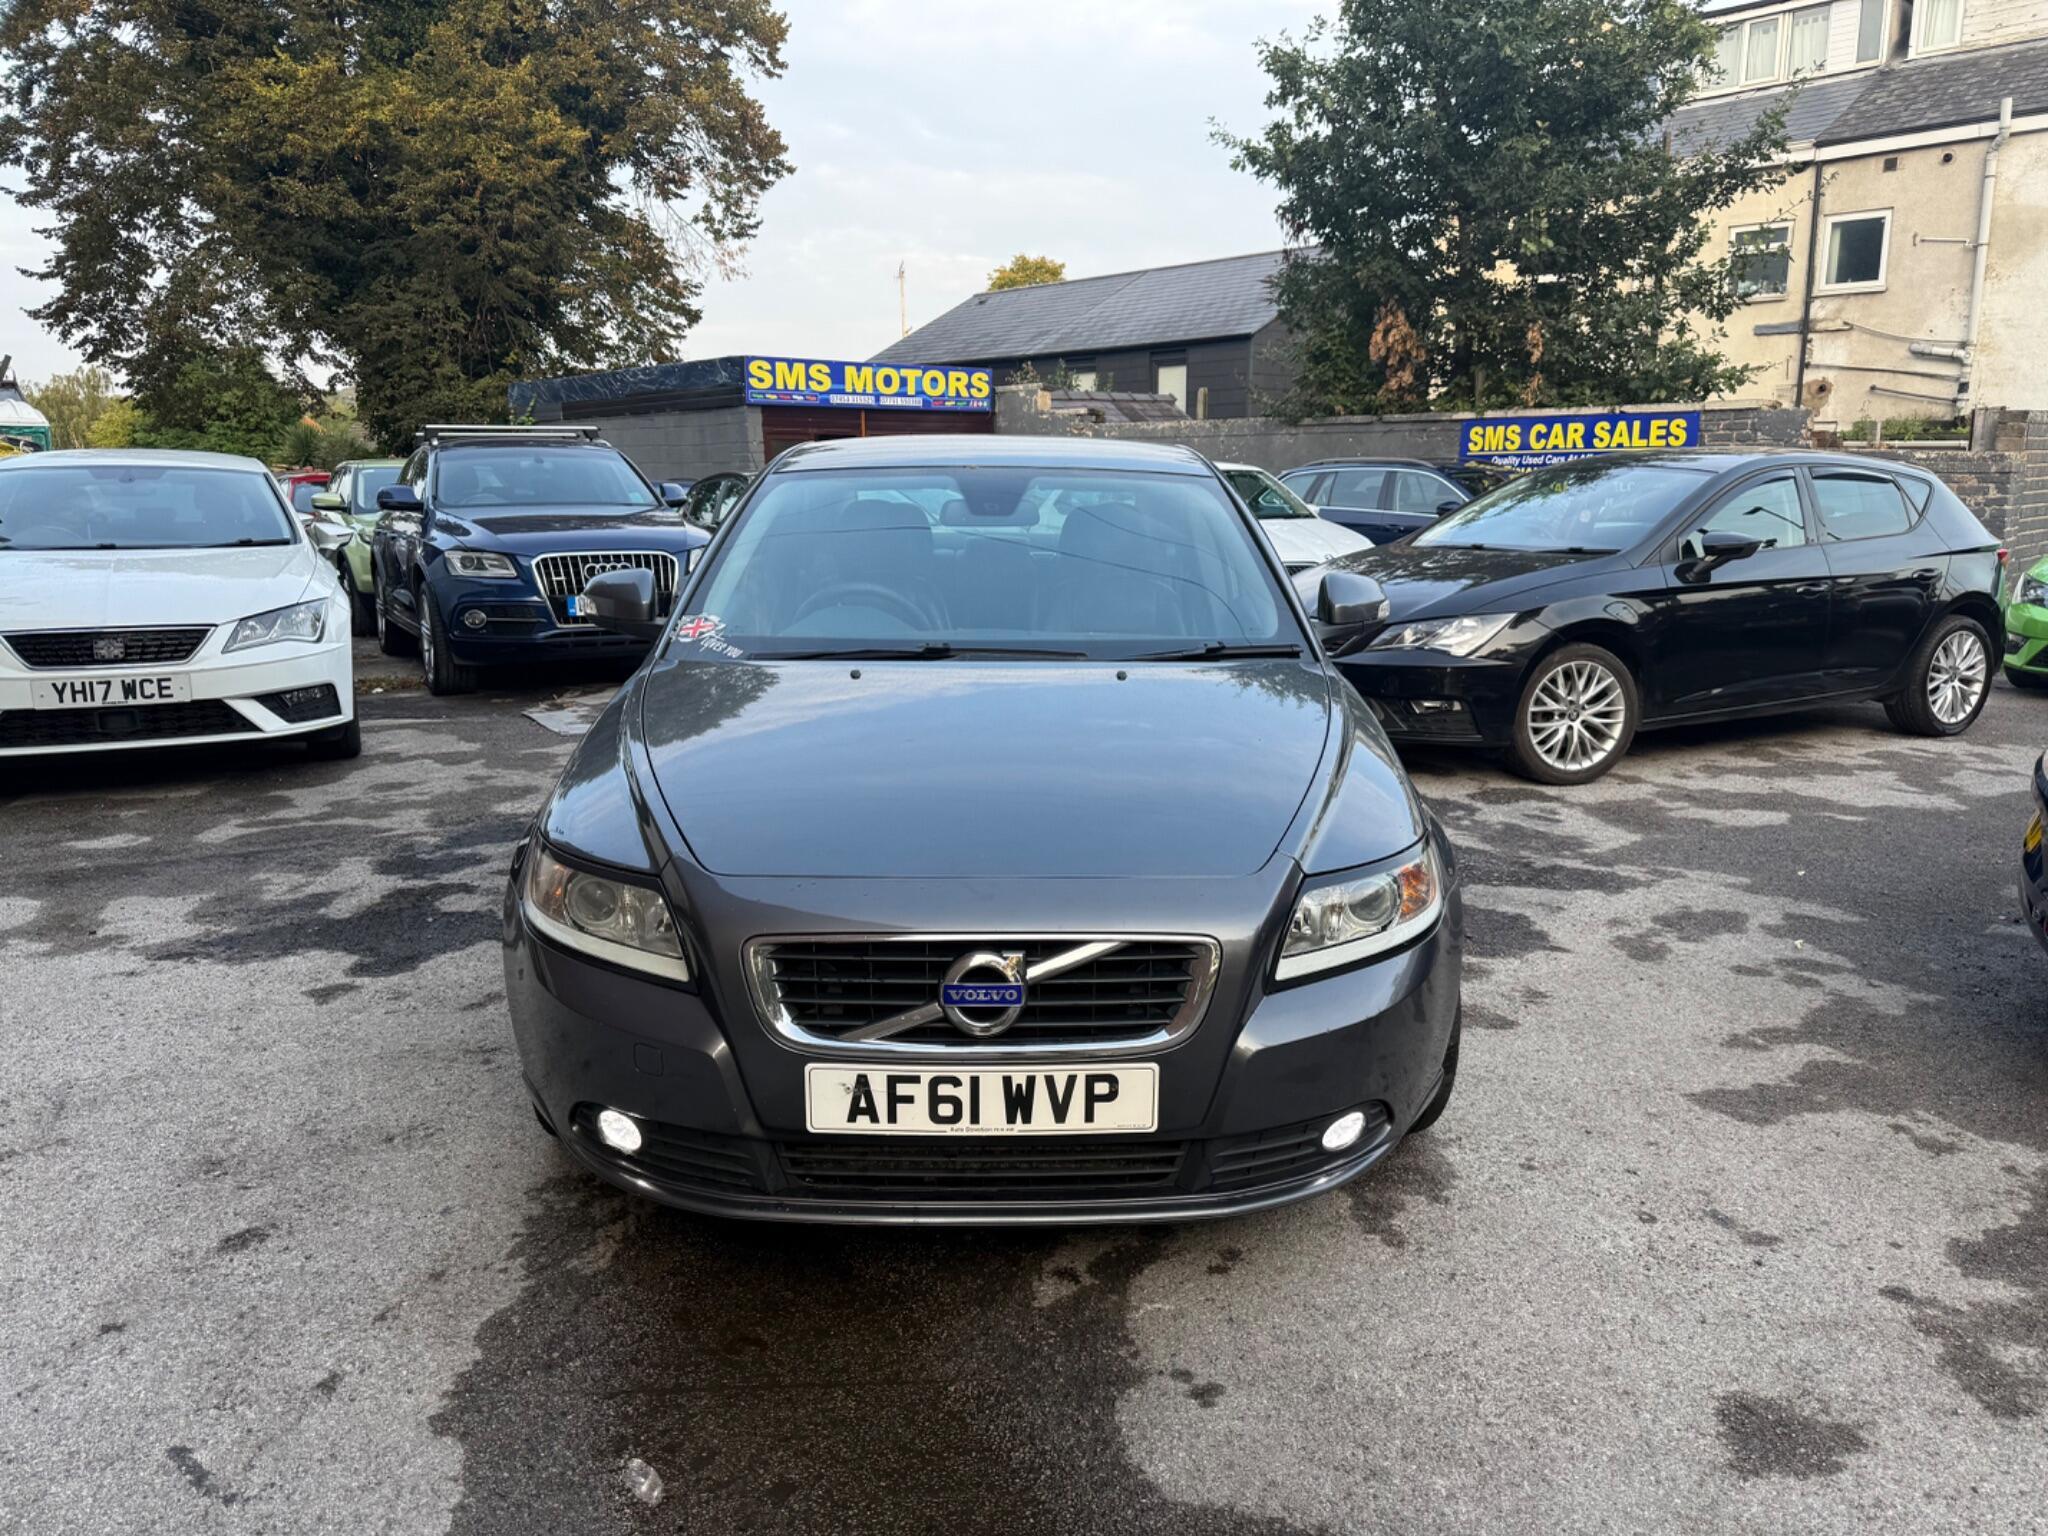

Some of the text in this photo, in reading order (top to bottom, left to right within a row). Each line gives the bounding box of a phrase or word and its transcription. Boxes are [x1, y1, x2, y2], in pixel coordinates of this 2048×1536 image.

[748, 359, 990, 399] SMS MOTORS
[1468, 418, 1688, 452] SMS CAR SALES
[1491, 454, 1521, 467] Quality
[1521, 454, 1544, 465] Used
[1545, 454, 1567, 465] Cars
[51, 677, 174, 704] YH17 WCE
[947, 989, 1018, 1001] VOLVO
[846, 1073, 1119, 1125] AF61 WVP
